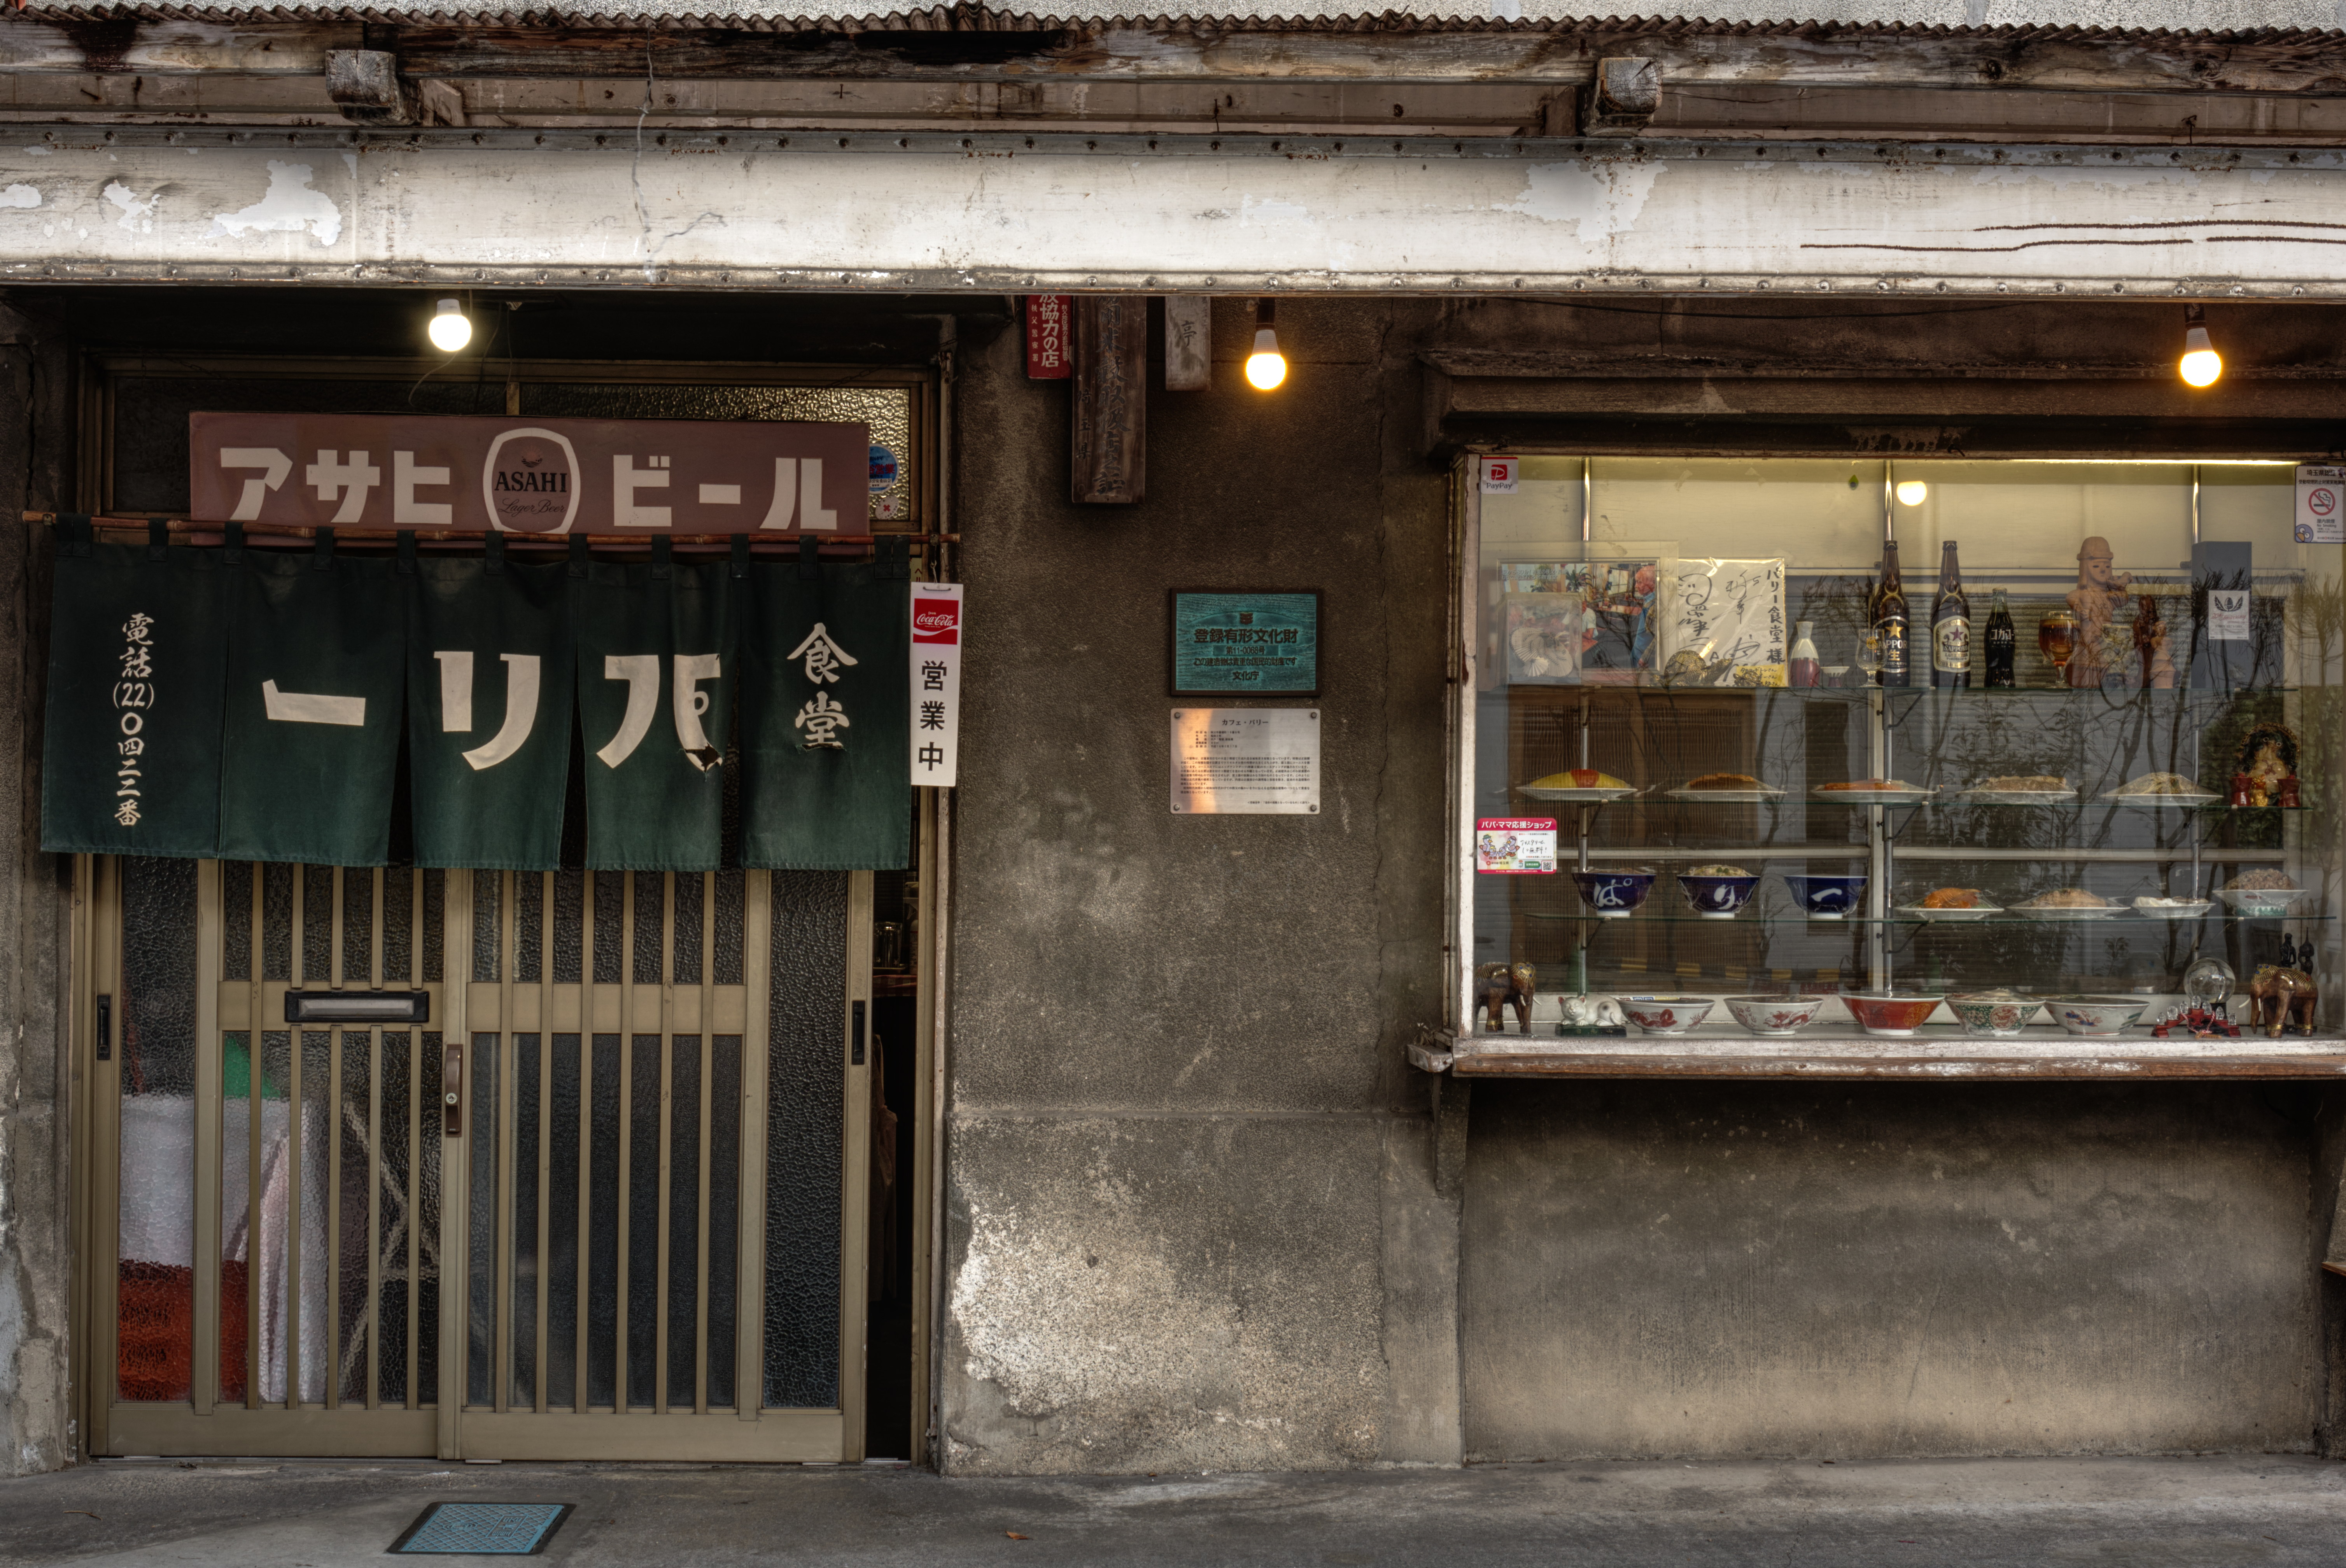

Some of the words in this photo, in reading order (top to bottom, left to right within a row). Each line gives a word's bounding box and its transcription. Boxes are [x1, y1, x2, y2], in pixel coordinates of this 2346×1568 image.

[494, 471, 567, 492] ASAHI
[498, 498, 537, 517] Lager
[532, 499, 566, 514] Beer
[916, 613, 955, 626] Coca-Cola
[1194, 628, 1299, 644] 登録有形文化財
[1226, 646, 1265, 655] 第11-0068号
[1888, 649, 1900, 661] 生
[1193, 657, 1297, 666] この建造物は貴重な国民的財産です
[1233, 671, 1259, 681] 文化庁
[786, 622, 859, 751] 食堂
[918, 660, 947, 771] 営業中
